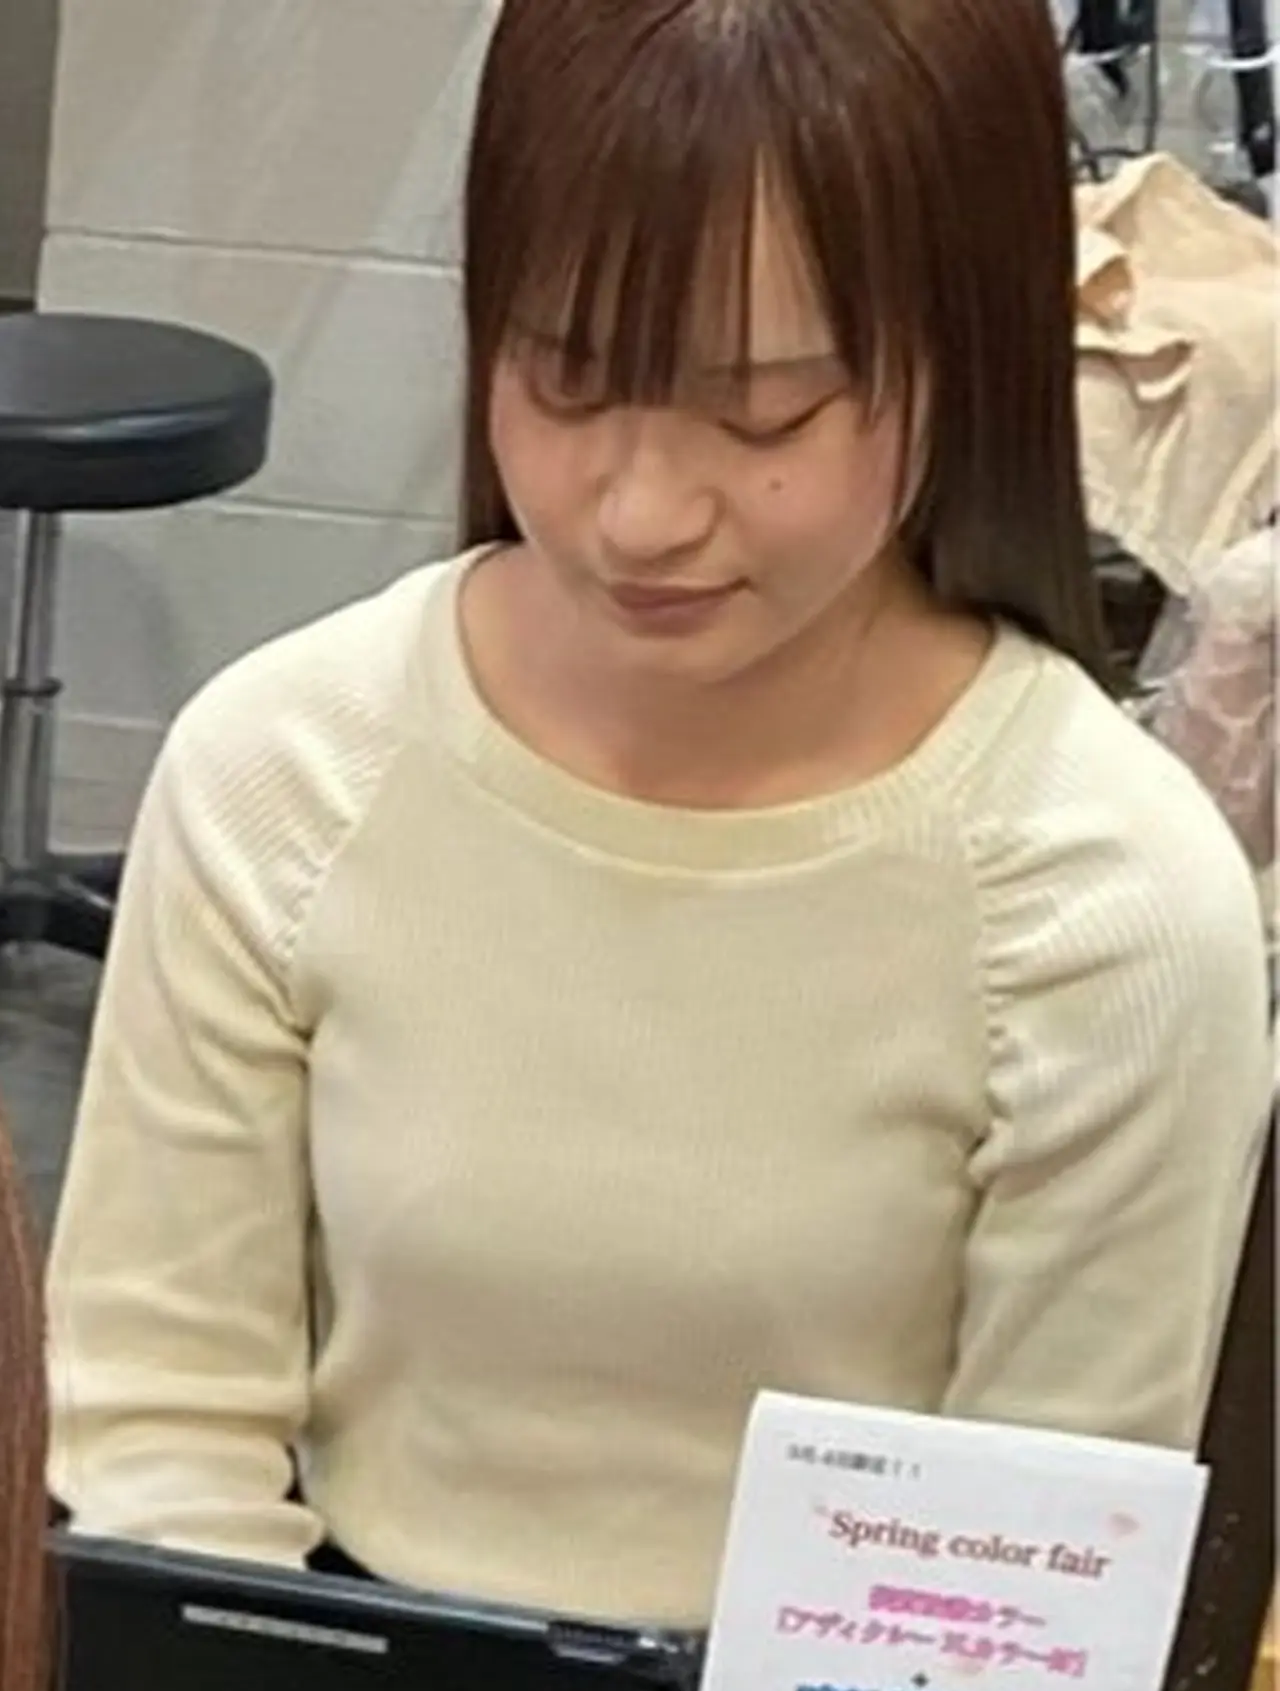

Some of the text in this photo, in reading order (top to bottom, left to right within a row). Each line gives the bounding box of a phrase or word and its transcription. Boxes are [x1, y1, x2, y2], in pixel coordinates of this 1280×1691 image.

[829, 1510, 1112, 1579] Spring color fair
